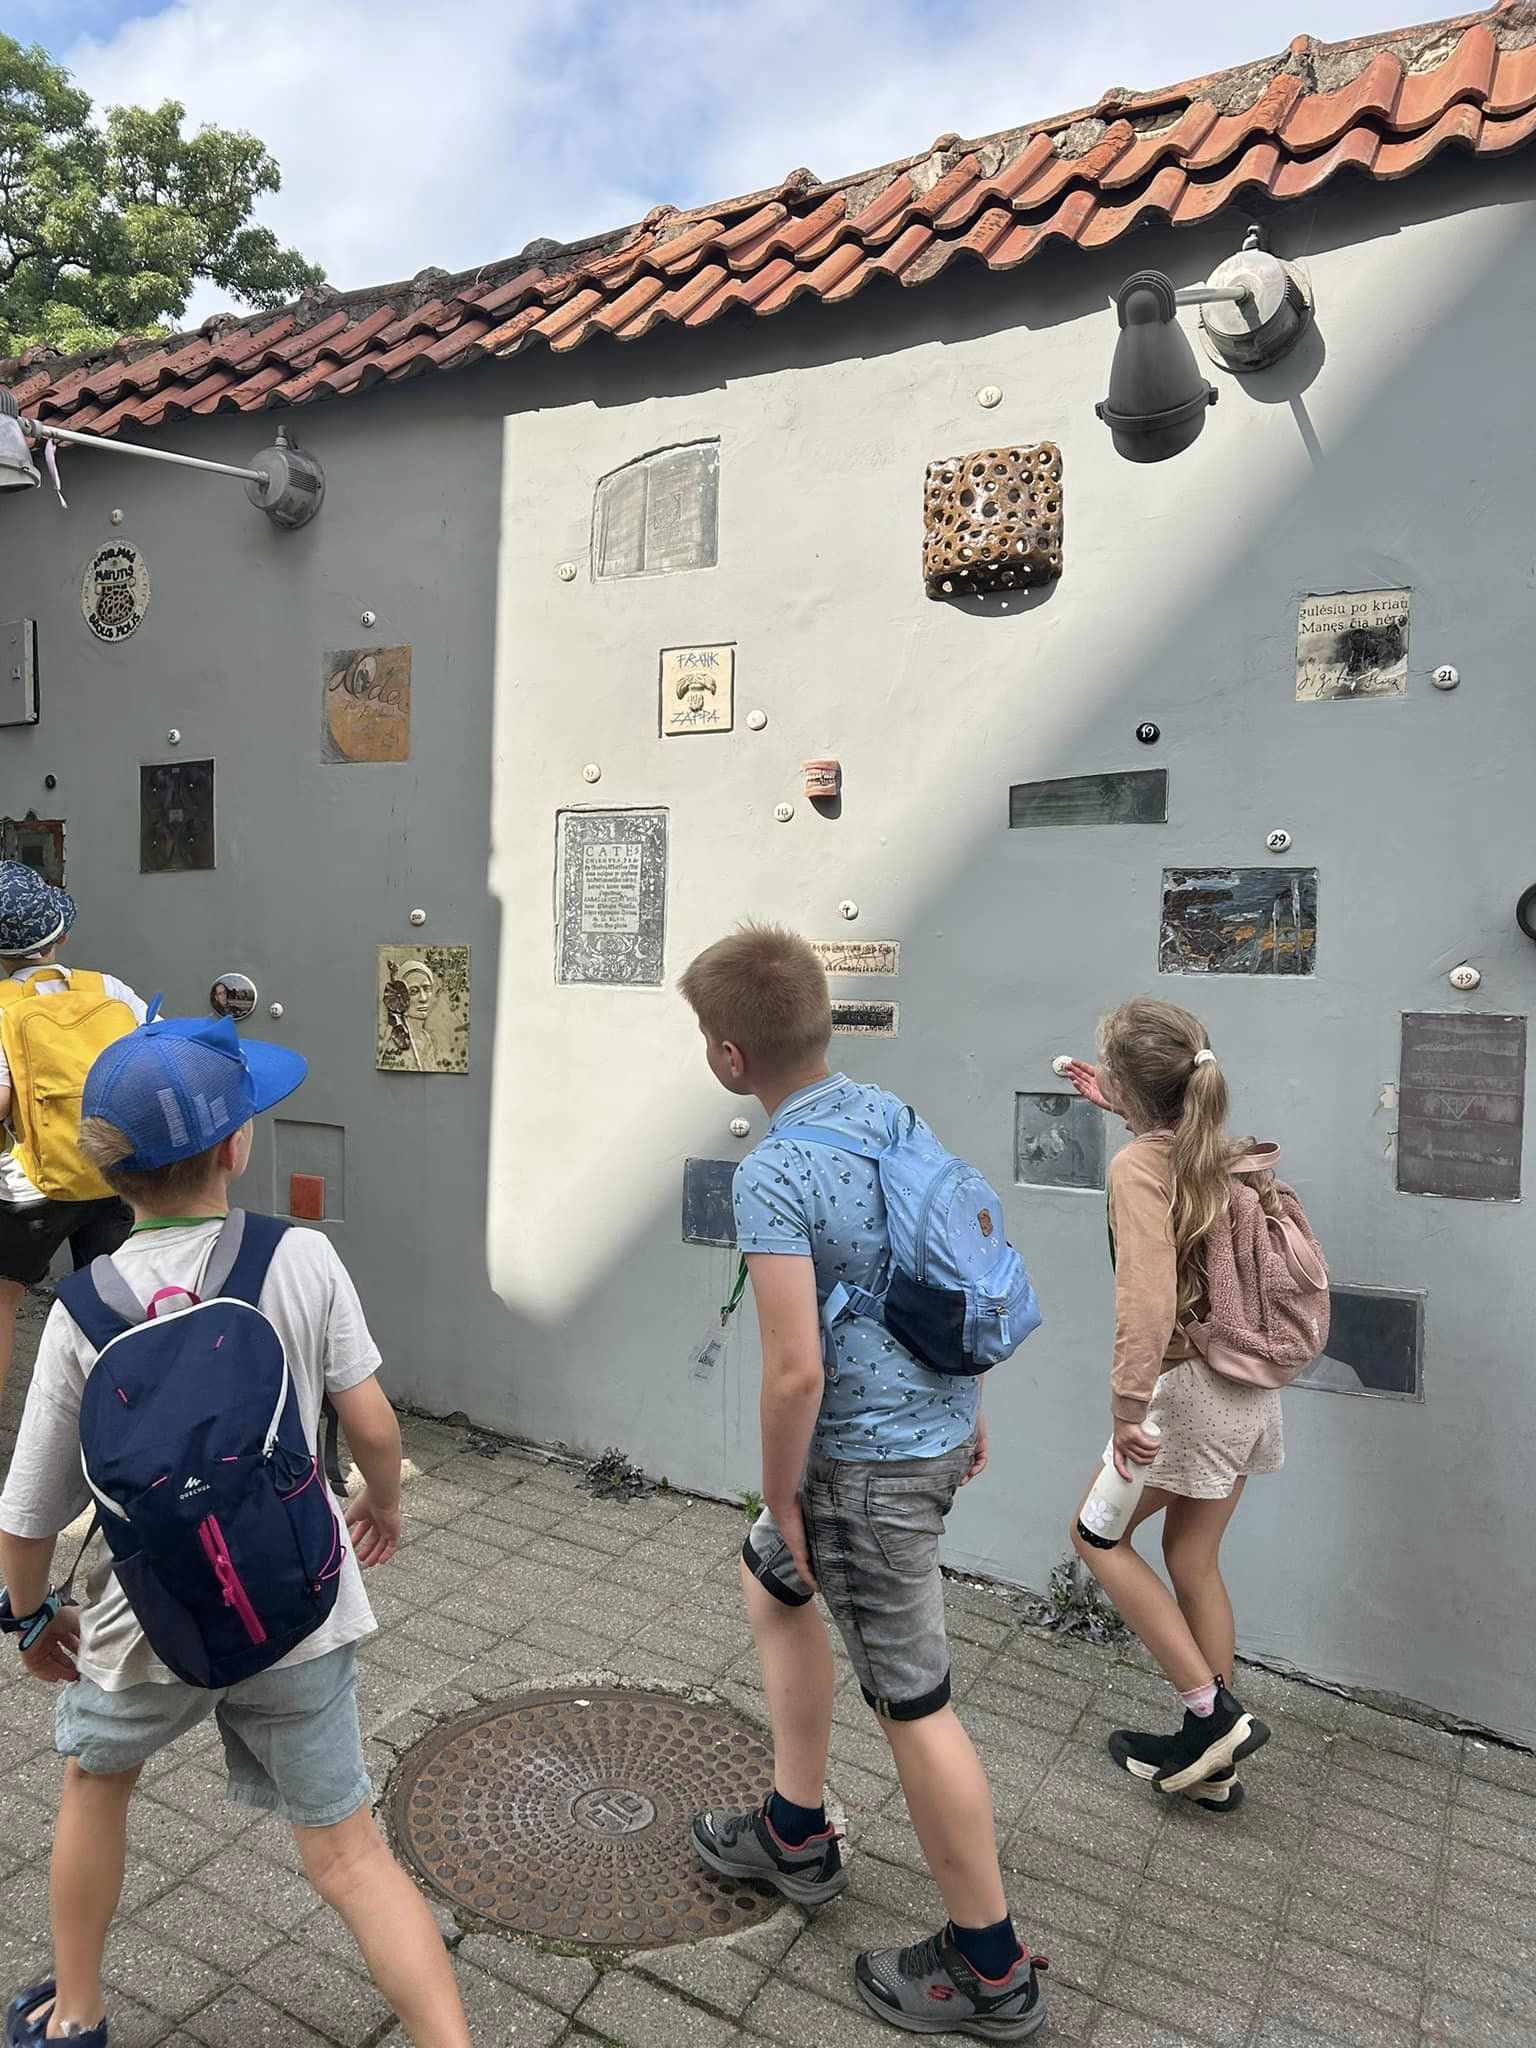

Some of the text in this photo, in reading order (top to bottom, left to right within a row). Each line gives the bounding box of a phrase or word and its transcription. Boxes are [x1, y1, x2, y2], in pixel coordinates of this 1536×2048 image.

[1351, 603, 1368, 615] po
[1350, 617, 1369, 629] čia
[676, 651, 720, 668] FRANK
[1439, 671, 1453, 682] 21
[670, 709, 720, 725] ZAPPA
[1140, 726, 1155, 739] 19
[1270, 833, 1285, 847] 29
[1456, 972, 1473, 985] 49
